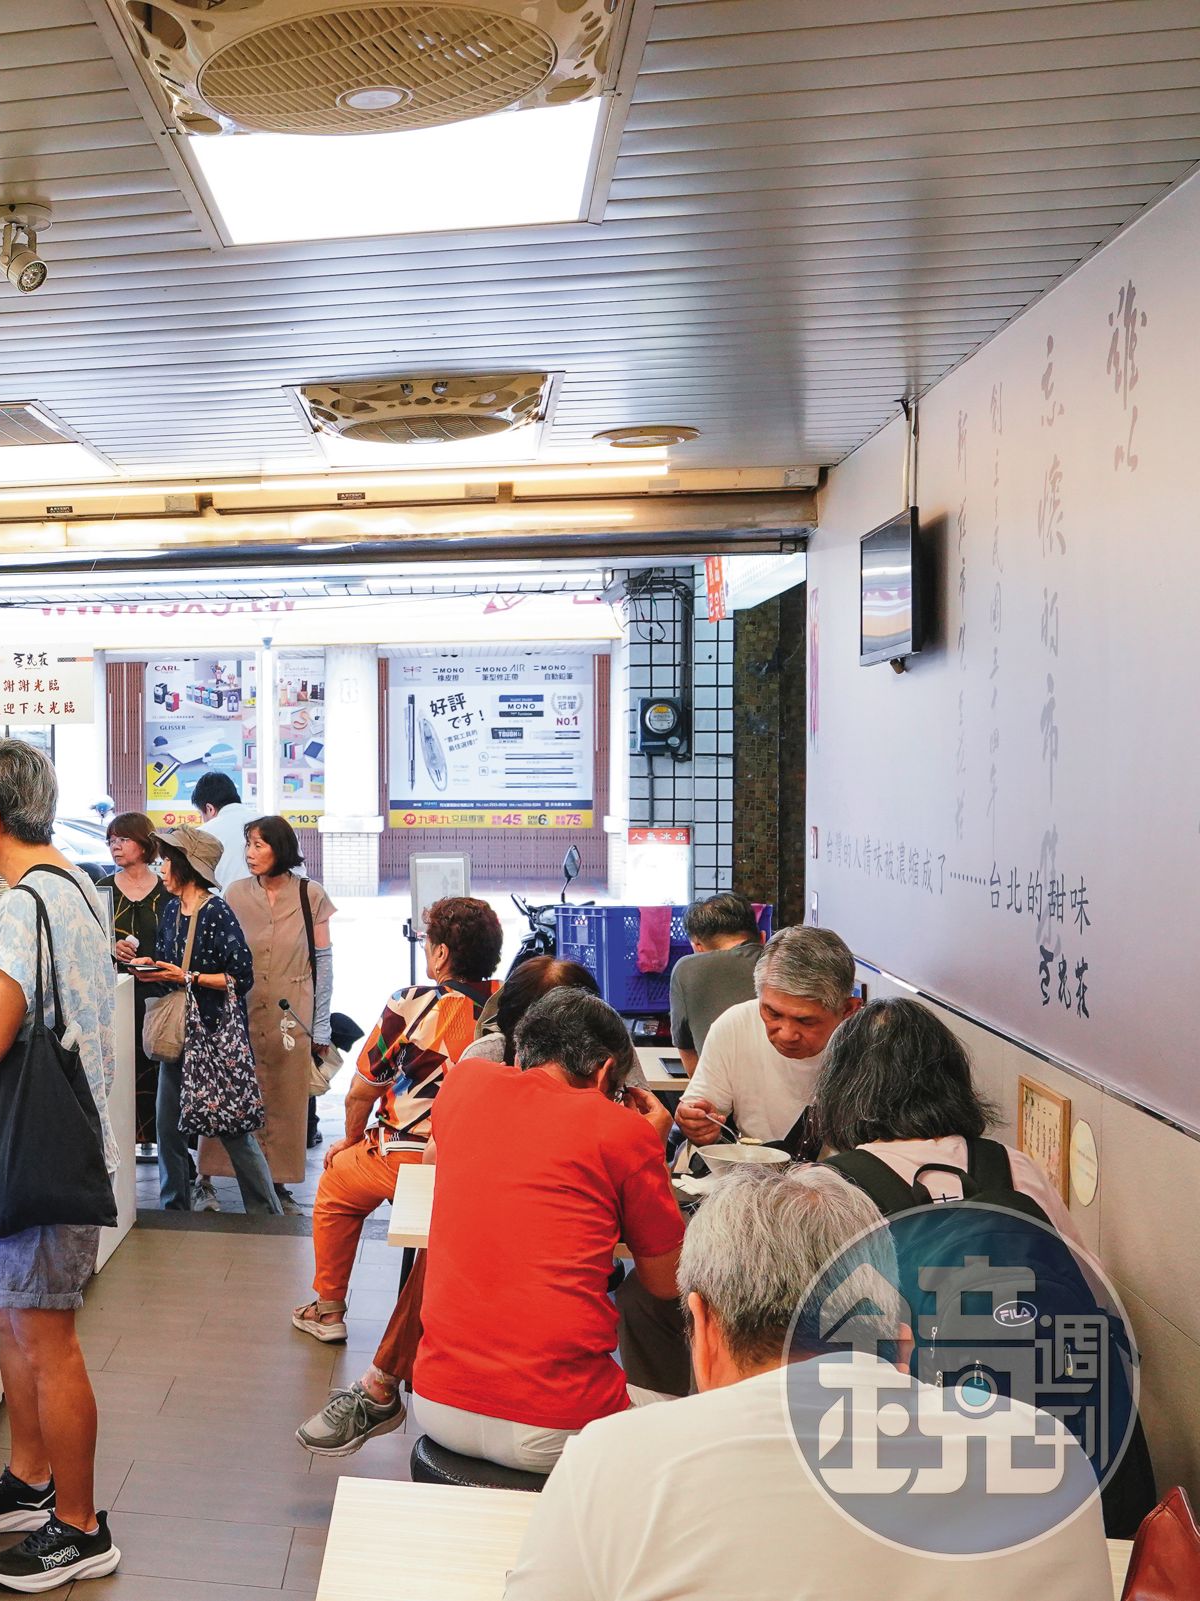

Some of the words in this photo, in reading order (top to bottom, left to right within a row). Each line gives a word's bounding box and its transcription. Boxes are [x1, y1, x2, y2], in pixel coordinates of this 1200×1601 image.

[3, 679, 60, 692] 謝謝光臨
[430, 692, 466, 717] 好評
[999, 1307, 1030, 1322] FILA
[41, 1545, 80, 1570] HOKA
